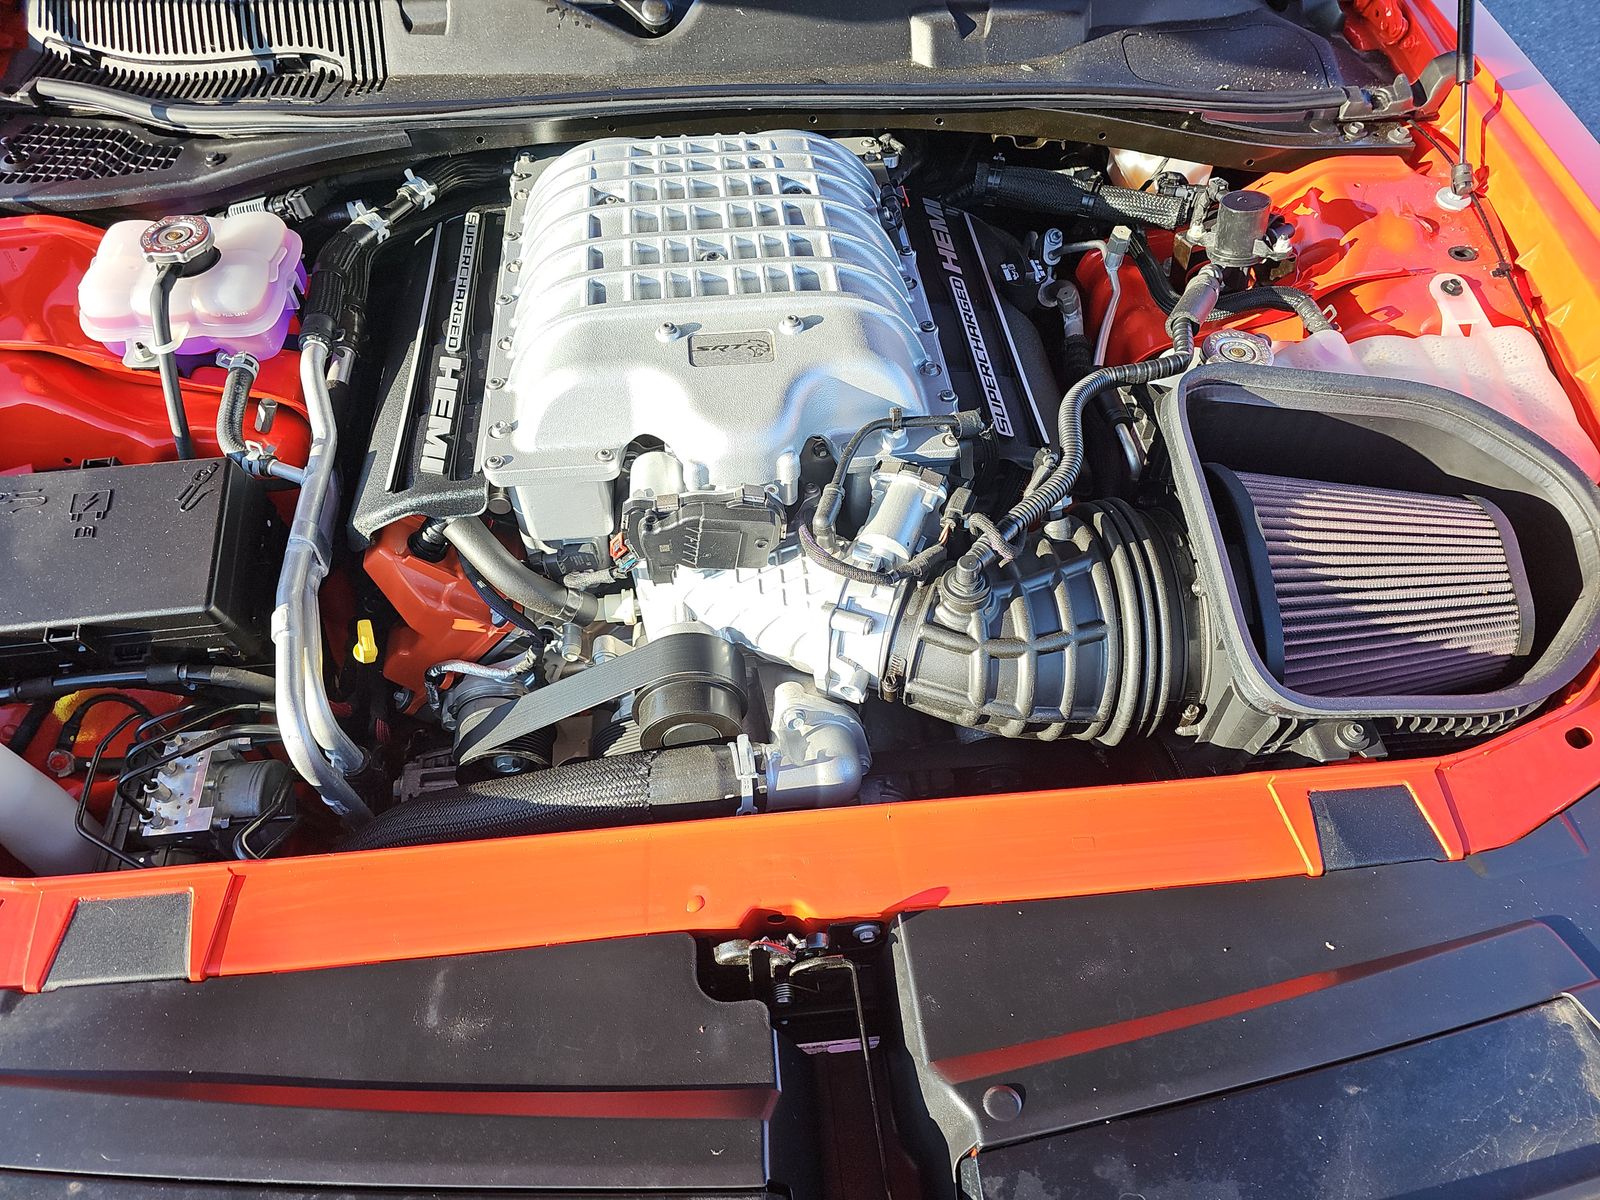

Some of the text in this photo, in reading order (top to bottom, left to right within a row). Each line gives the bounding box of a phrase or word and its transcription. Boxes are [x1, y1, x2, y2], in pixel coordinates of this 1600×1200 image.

[923, 198, 962, 275] HEMI
[420, 213, 478, 474] SUPERCHARGED HEMI
[697, 343, 747, 352] SRT
[953, 278, 1013, 435] SUPERCHARGED
